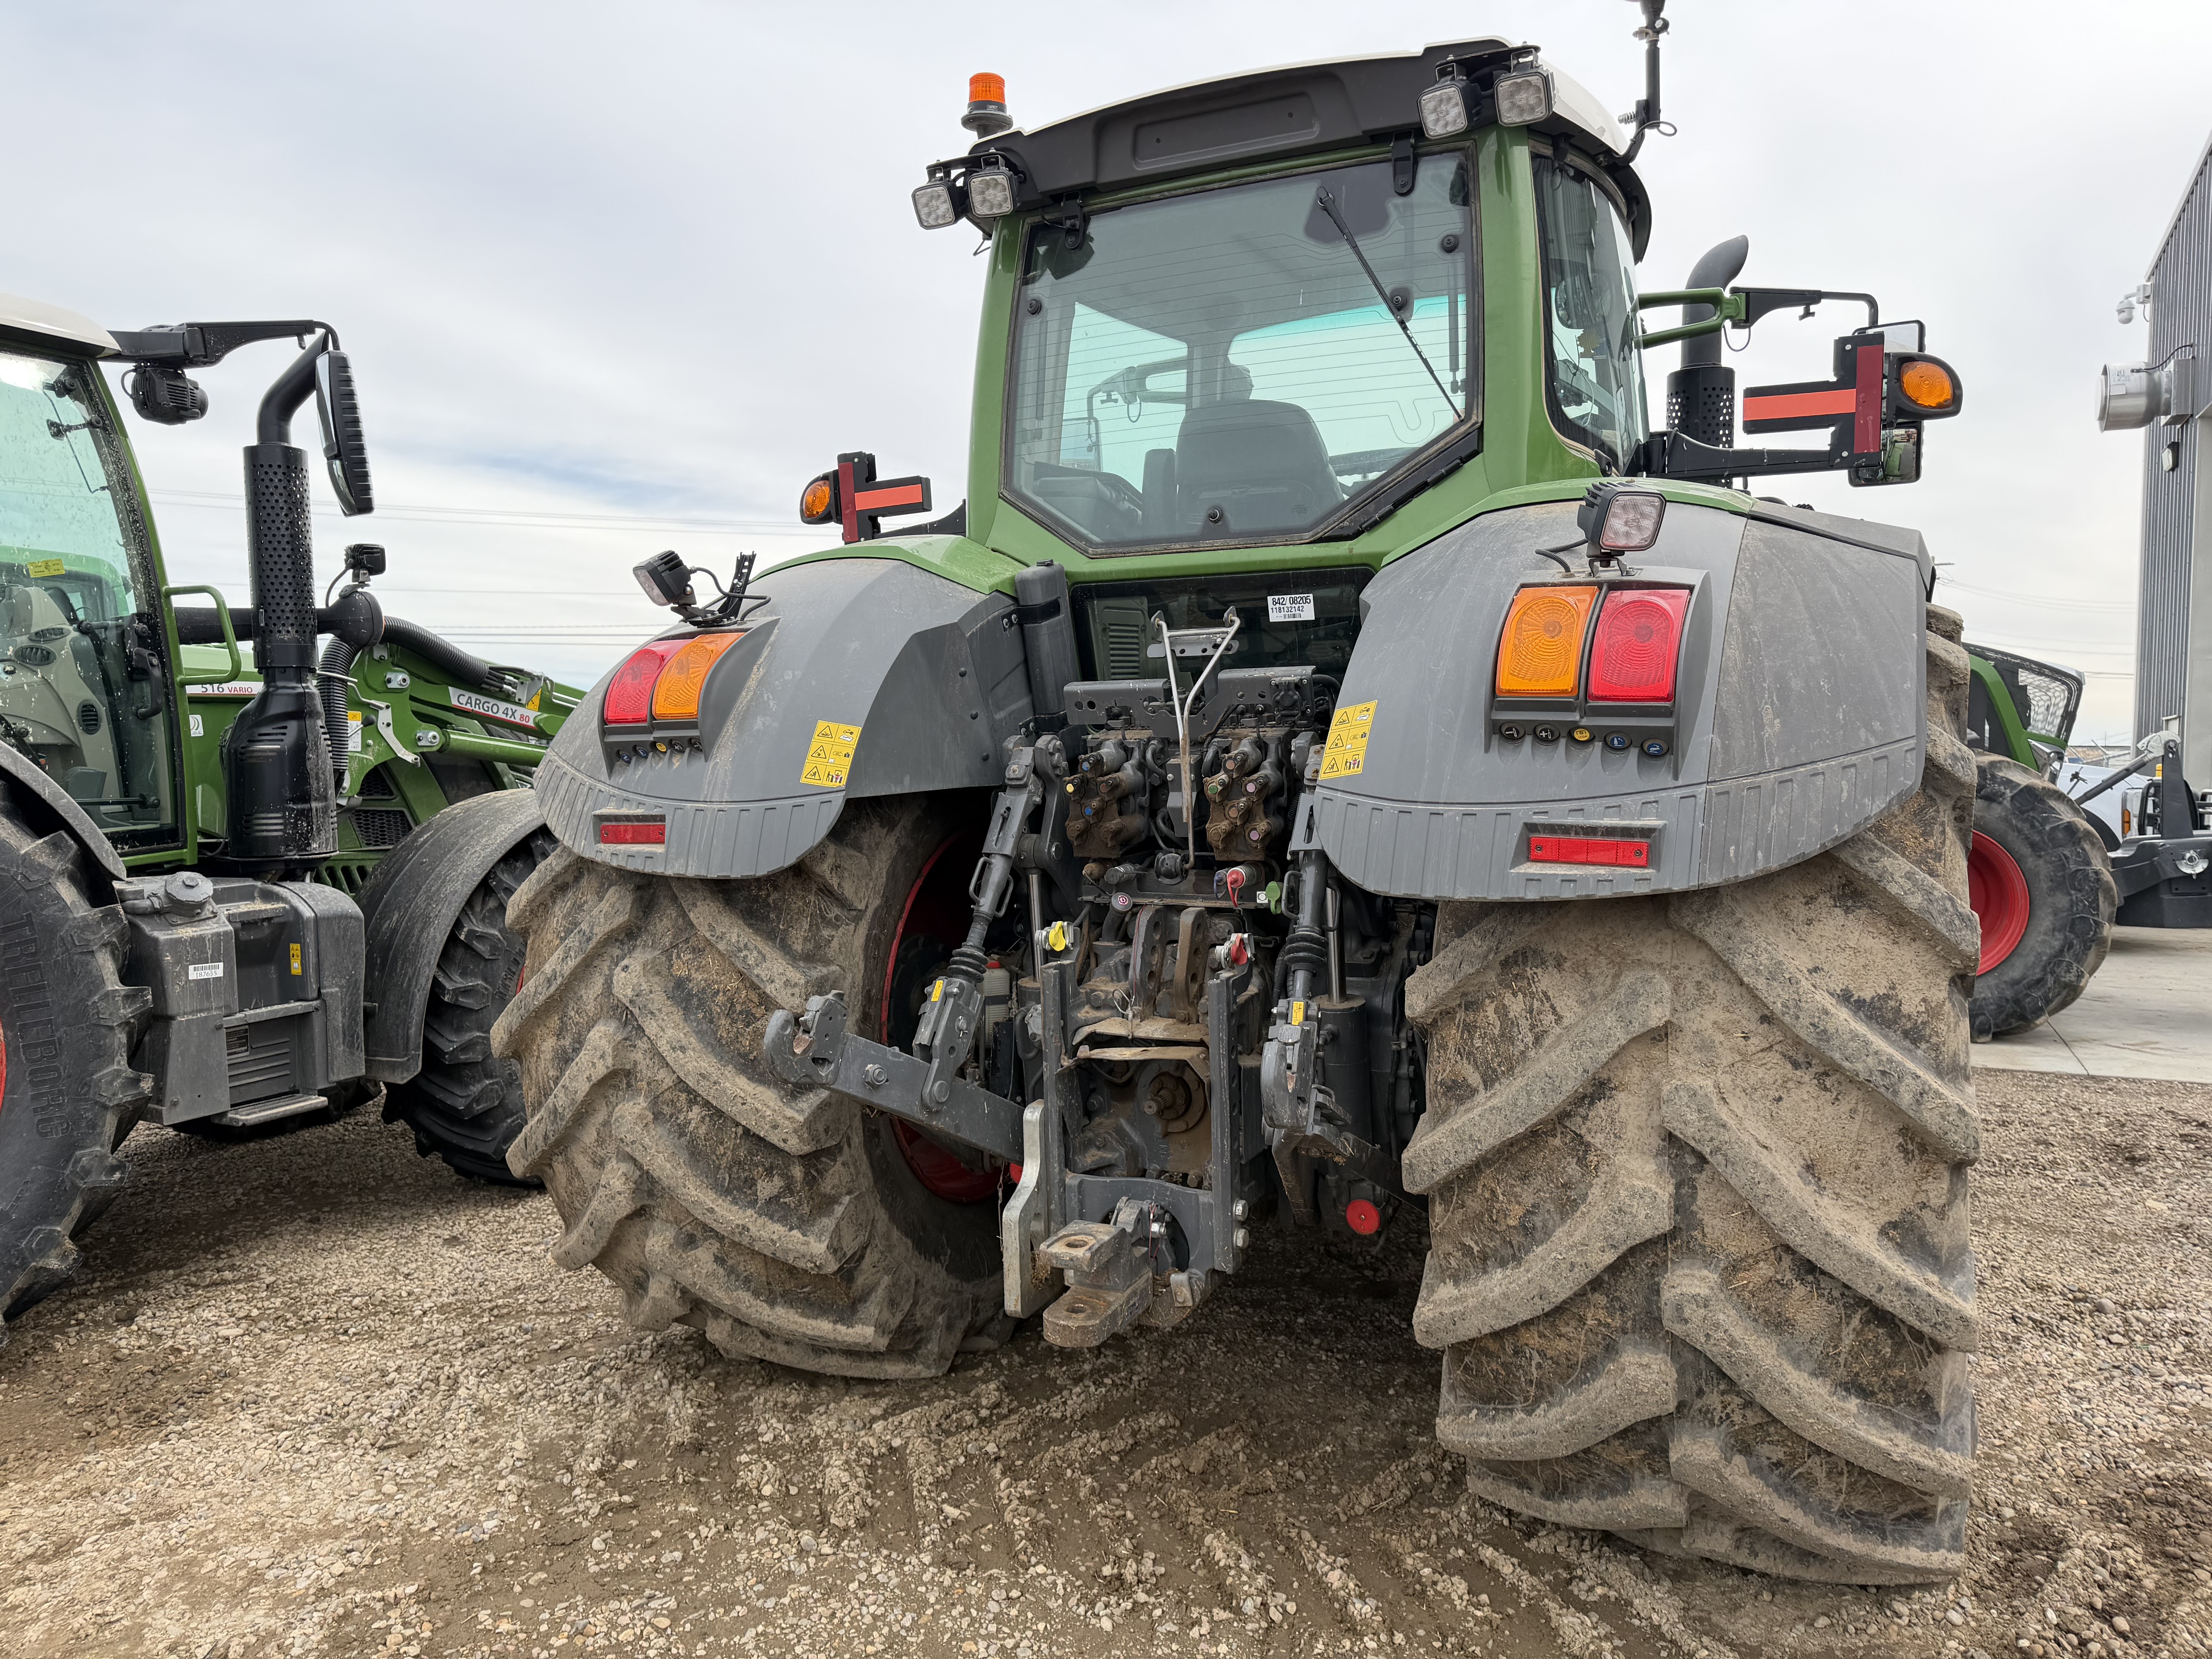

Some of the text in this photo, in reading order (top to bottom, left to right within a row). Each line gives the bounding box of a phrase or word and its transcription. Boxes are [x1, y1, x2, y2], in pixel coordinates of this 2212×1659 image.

[1272, 596, 1311, 606] 842/ 08205
[1270, 605, 1305, 613] 118132142
[201, 684, 225, 693] 516
[457, 694, 530, 723] CARGO 4X 80
[196, 970, 217, 978] 187655
[0, 910, 72, 1139] TRELLEBORG
